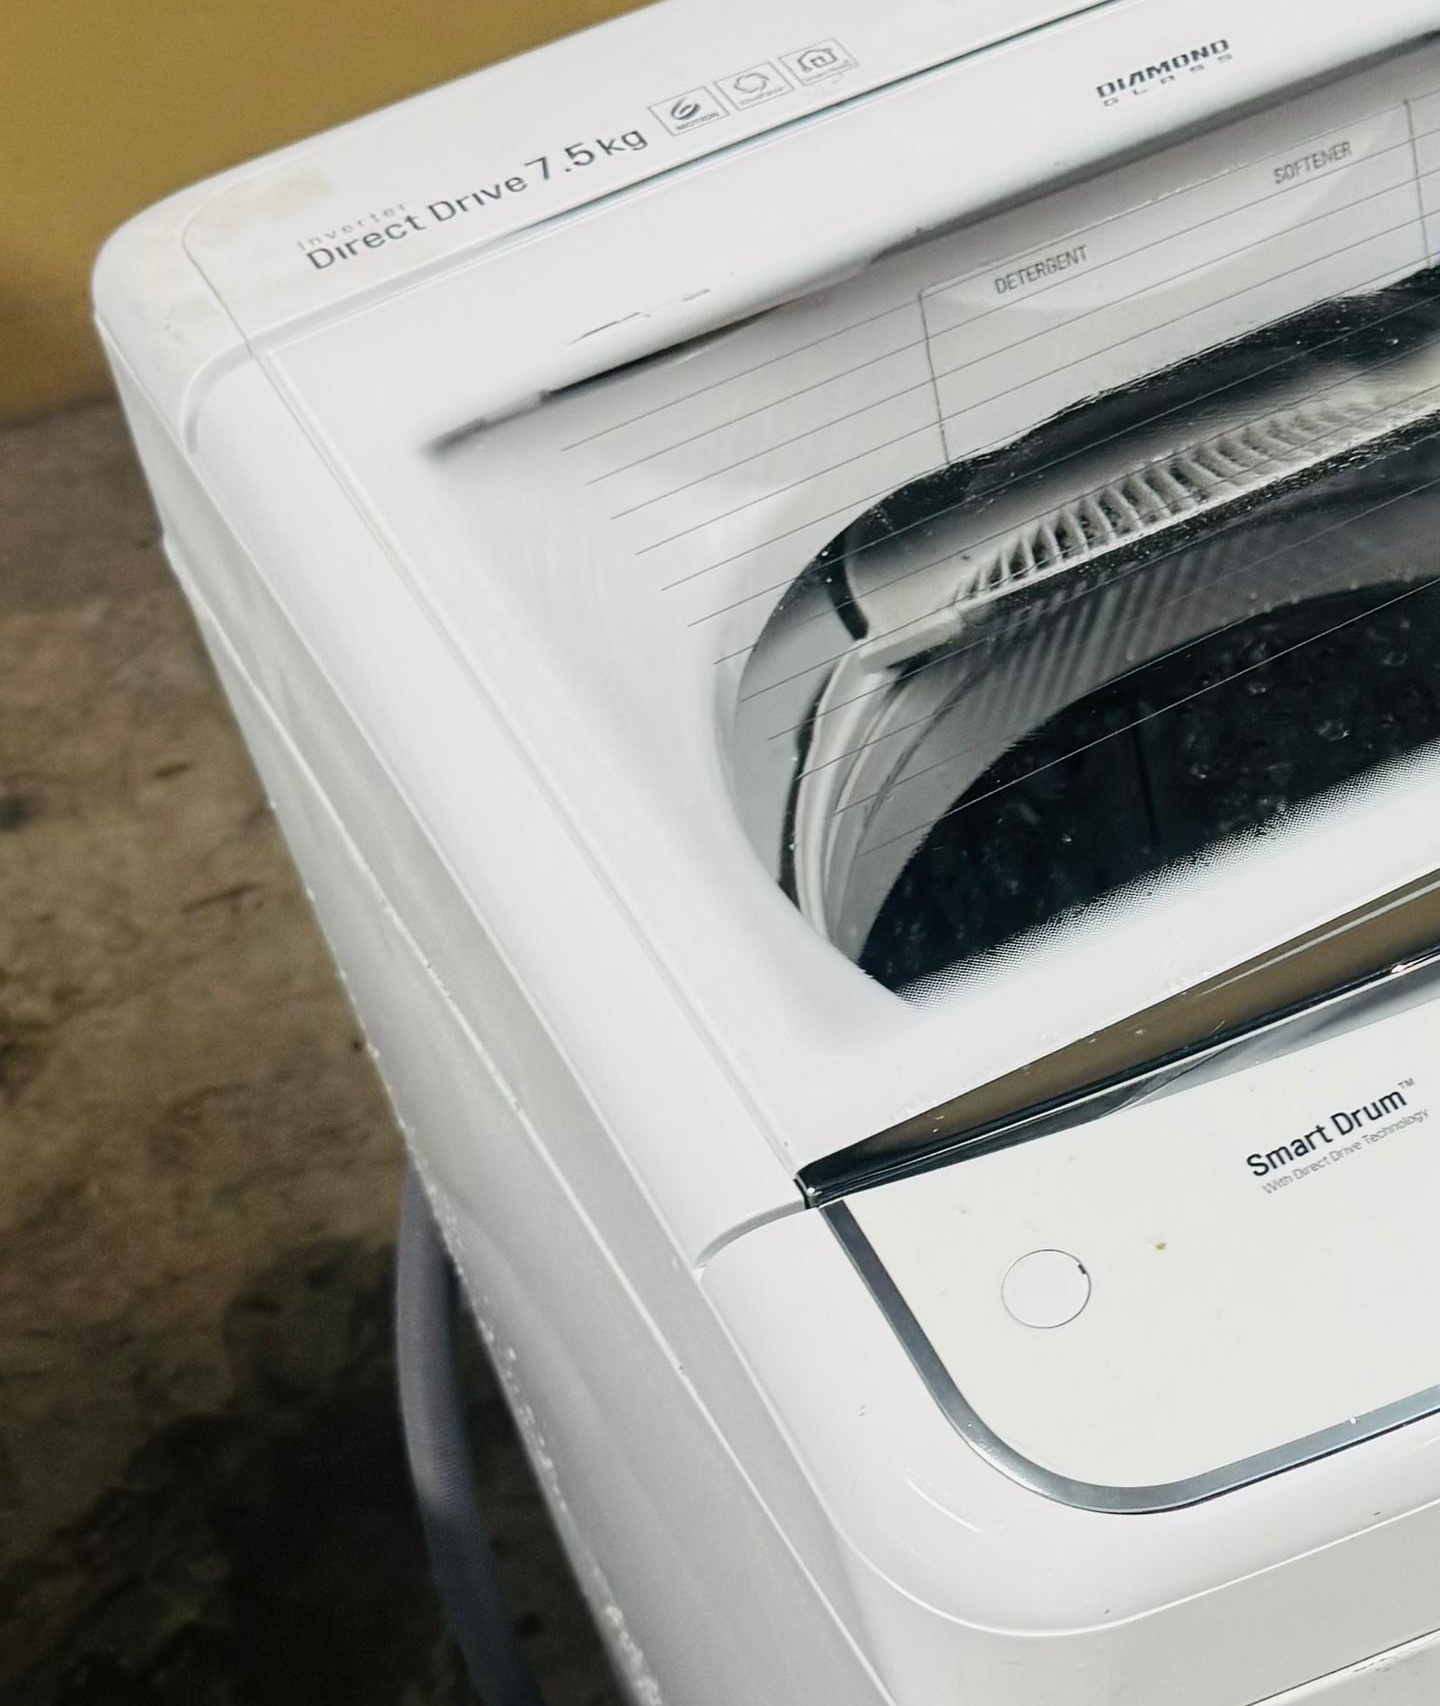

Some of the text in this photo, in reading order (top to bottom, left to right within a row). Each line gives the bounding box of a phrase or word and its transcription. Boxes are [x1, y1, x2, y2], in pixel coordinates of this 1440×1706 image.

[1096, 38, 1230, 98] DIAMOND
[1273, 140, 1353, 185] SOFTENER
[306, 214, 427, 271] Direct
[427, 176, 528, 222] Drive
[995, 245, 1089, 294] DETERGENT
[1246, 1125, 1333, 1177] Smart
[1362, 1109, 1430, 1145] Technology
